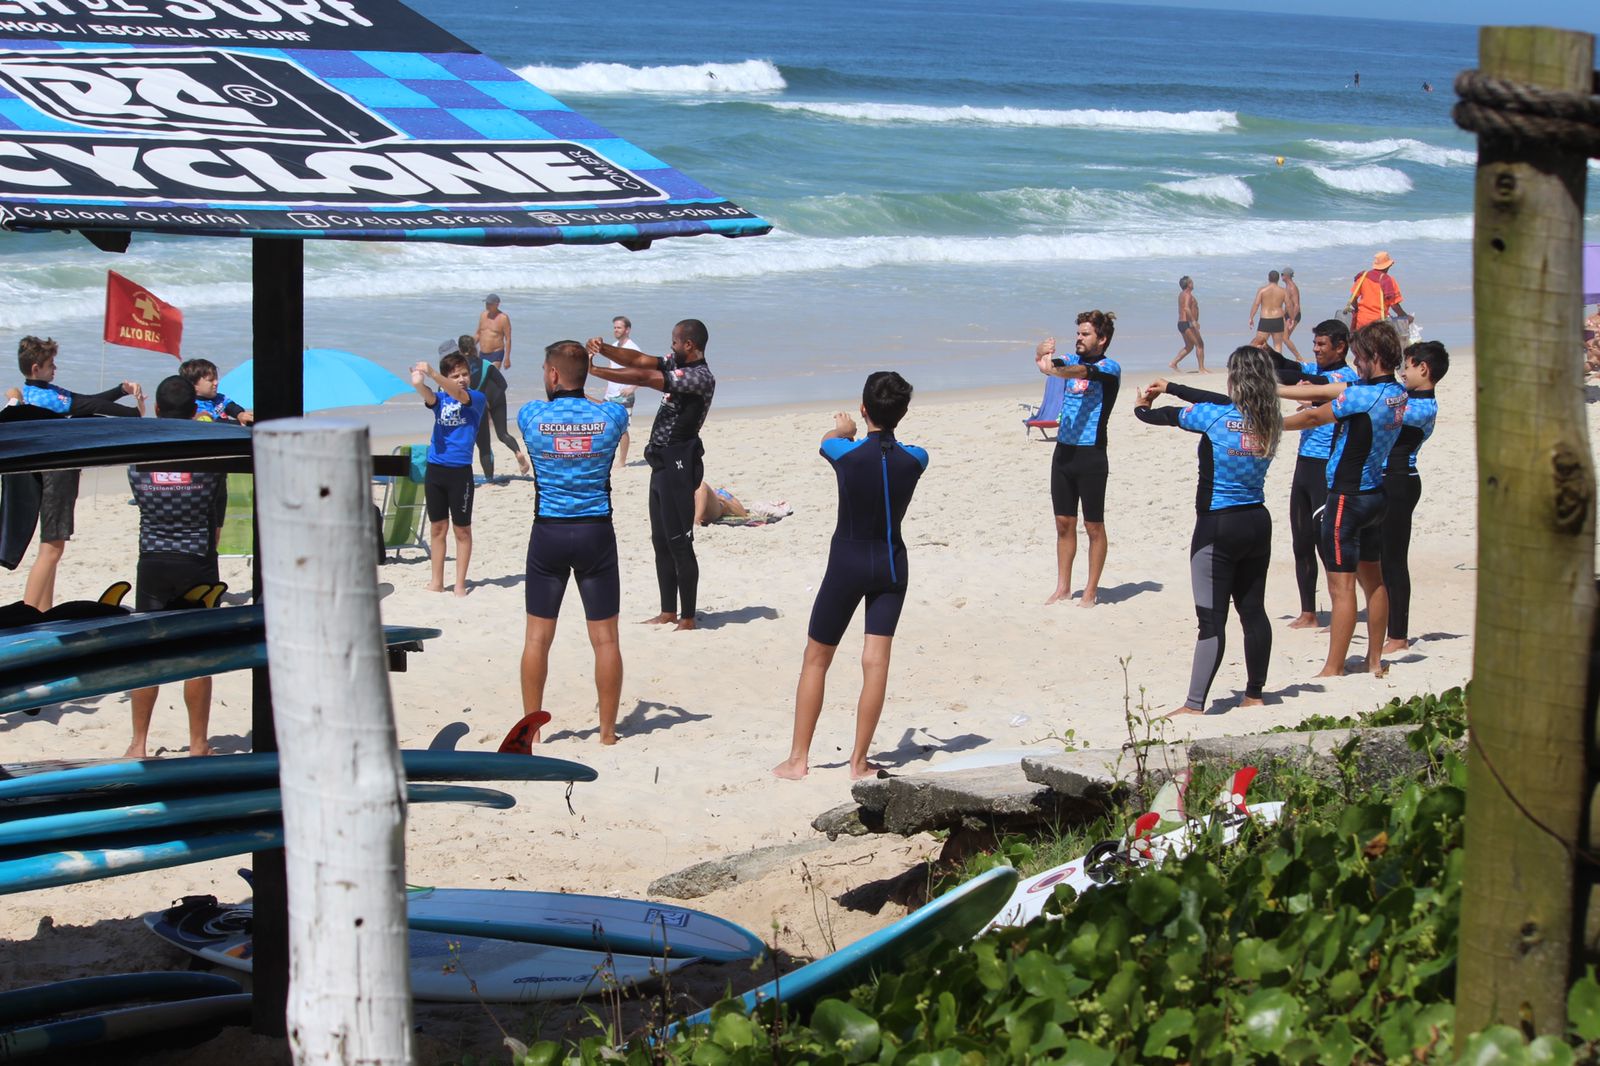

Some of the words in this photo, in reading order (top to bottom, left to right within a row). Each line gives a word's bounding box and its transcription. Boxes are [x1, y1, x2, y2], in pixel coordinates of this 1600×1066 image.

[89, 24, 211, 38] ESCUELA
[206, 28, 249, 39] DE
[247, 29, 311, 42] SURF
[0, 141, 622, 194] CYCLONE
[328, 214, 433, 228] Cyclone
[433, 214, 513, 226] Brasil
[119, 326, 143, 340] ALTO
[539, 423, 572, 431] ESCOLA
[581, 422, 606, 431] SURF
